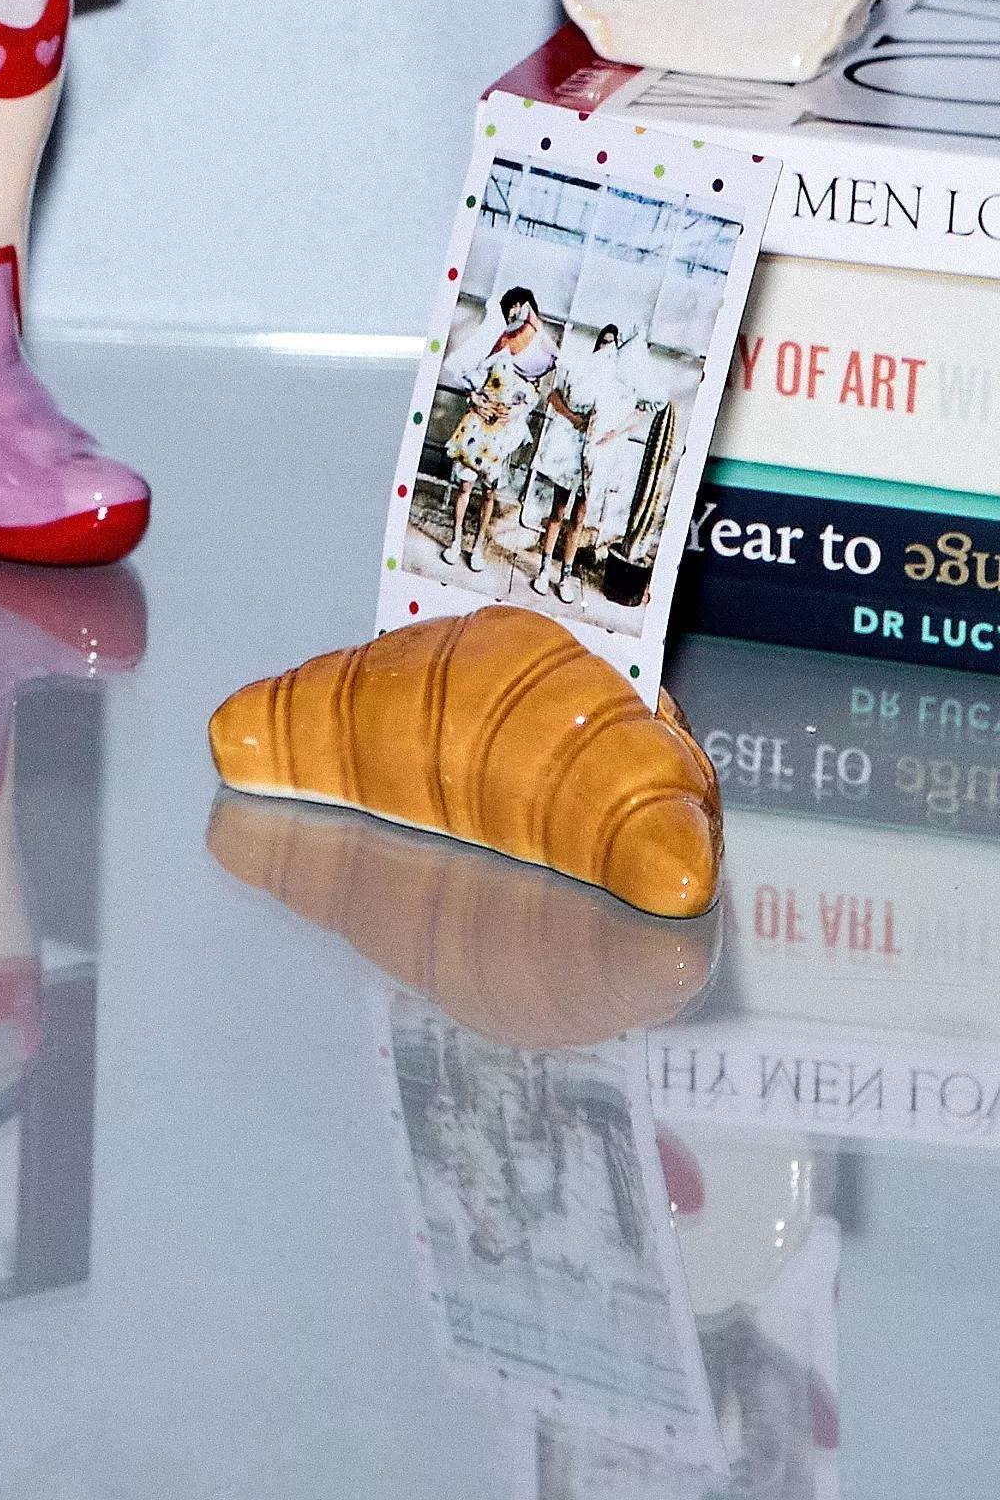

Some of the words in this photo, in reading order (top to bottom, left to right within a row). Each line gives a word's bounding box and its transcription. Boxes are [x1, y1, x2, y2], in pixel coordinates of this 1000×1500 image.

[793, 172, 924, 230] MEN
[727, 333, 765, 392] Y
[775, 340, 831, 400] OF
[838, 350, 927, 414] ART
[685, 502, 805, 565] Year
[819, 523, 882, 576] to
[853, 605, 905, 640] DR
[921, 615, 1000, 652] LUC
